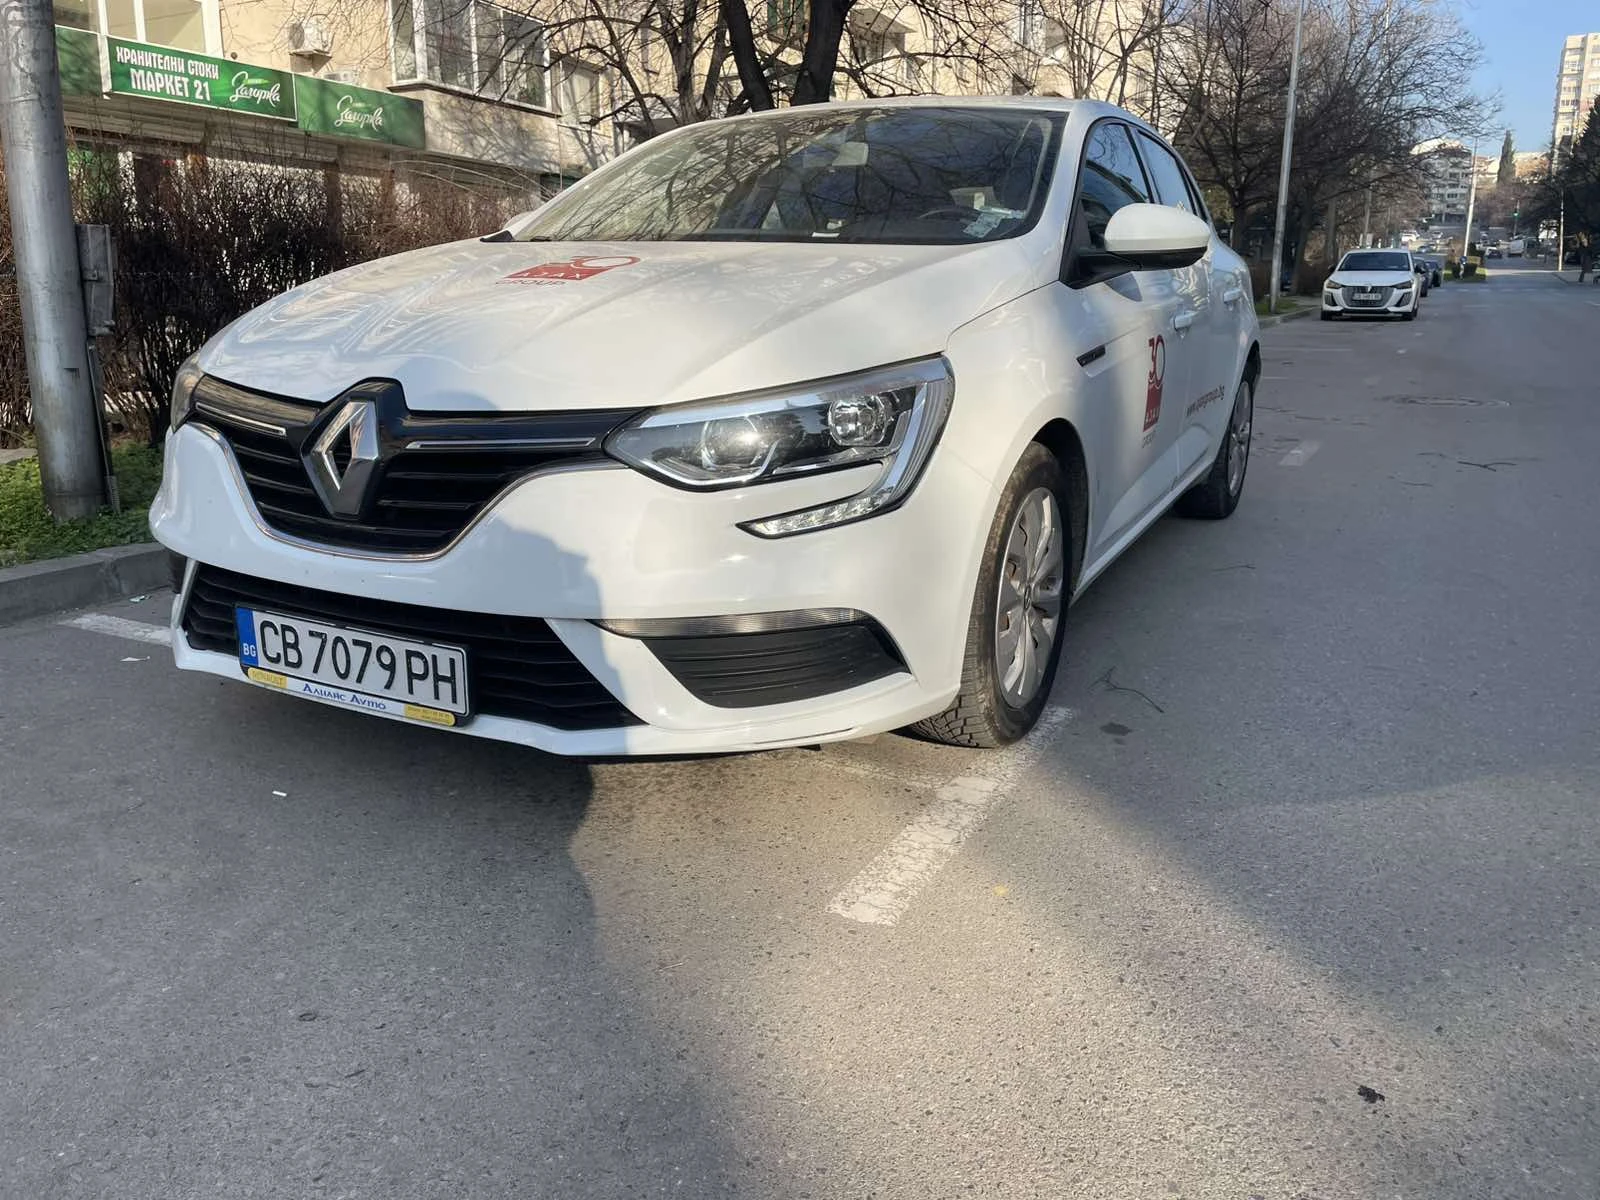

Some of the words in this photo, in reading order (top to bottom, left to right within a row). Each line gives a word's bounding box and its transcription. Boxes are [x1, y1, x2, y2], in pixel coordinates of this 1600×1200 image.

[115, 46, 185, 74] ХРАНИТЕЛНИ
[187, 59, 219, 80] СТОКИ
[130, 67, 190, 98] МАРКЕТ
[193, 79, 211, 101] 21
[242, 642, 257, 658] BG
